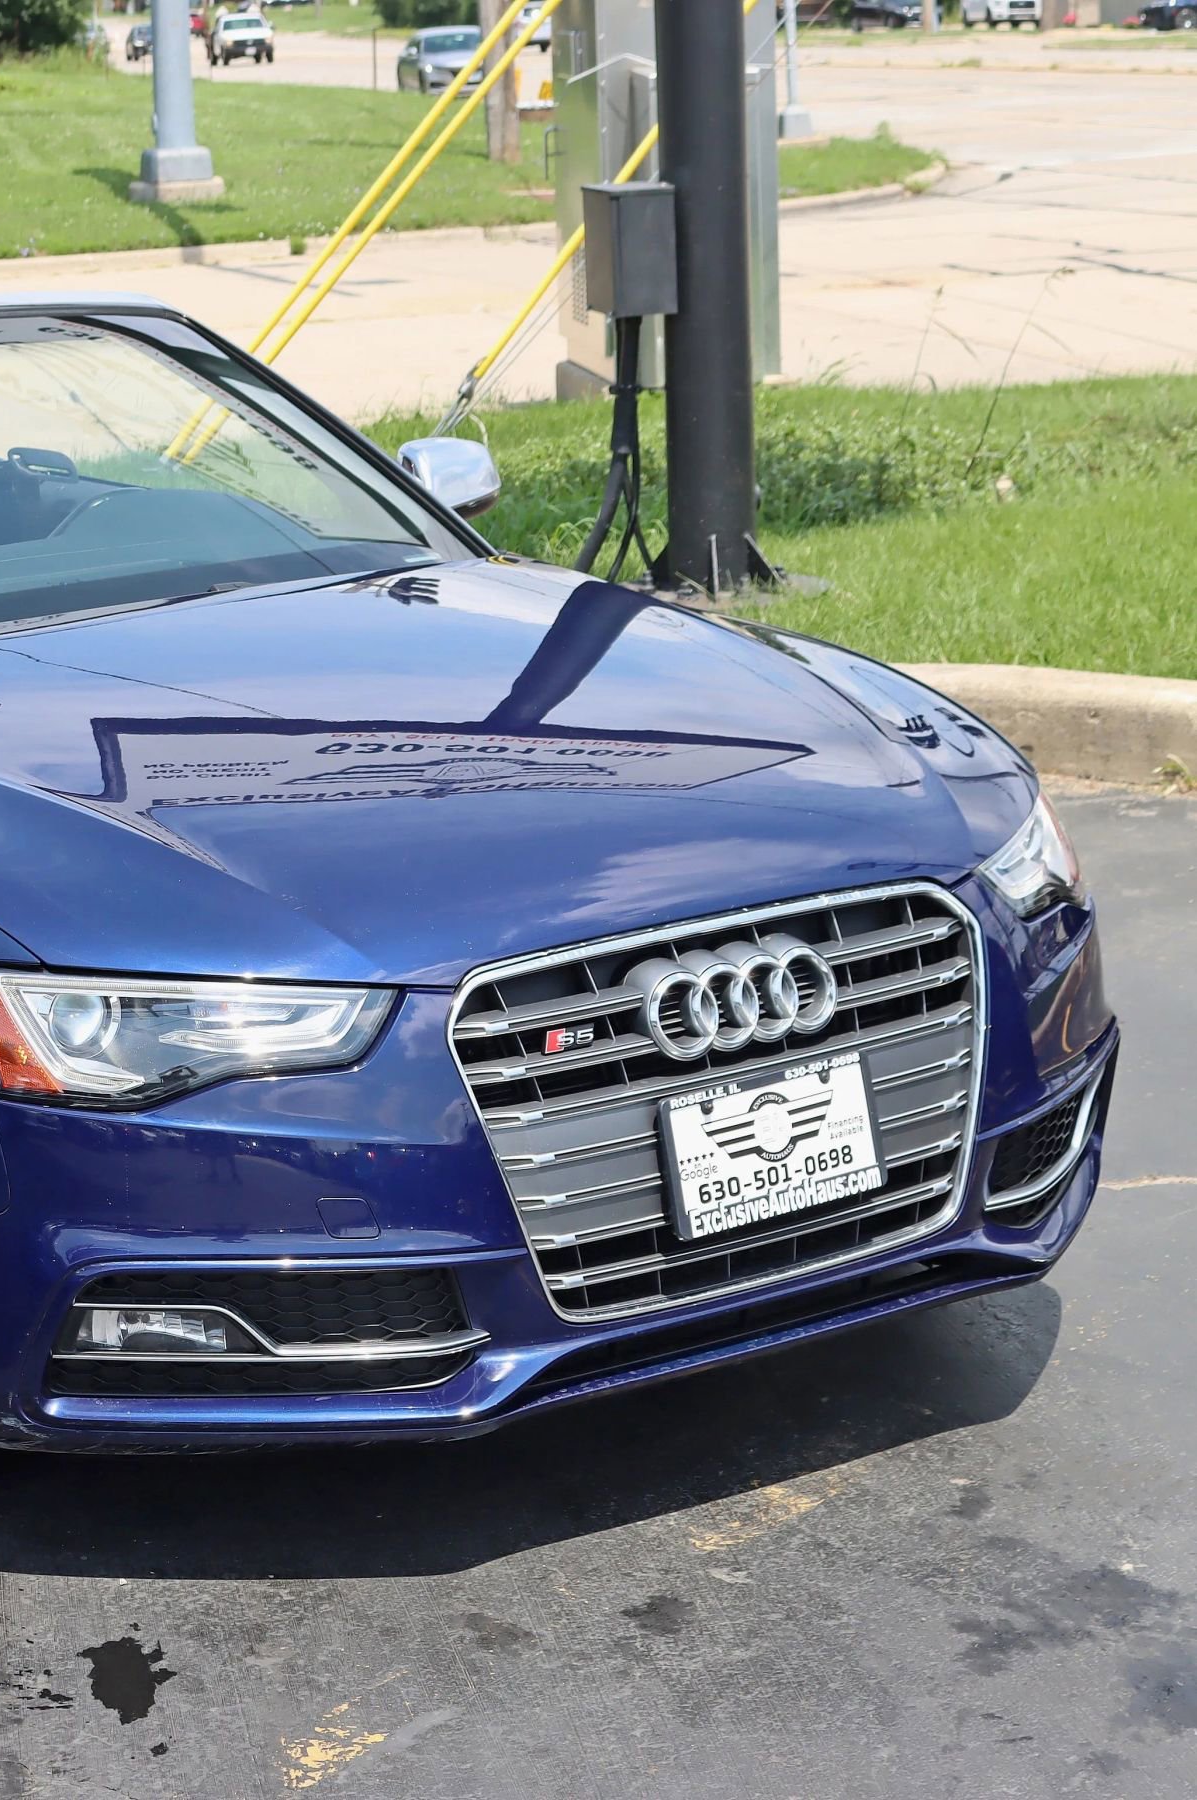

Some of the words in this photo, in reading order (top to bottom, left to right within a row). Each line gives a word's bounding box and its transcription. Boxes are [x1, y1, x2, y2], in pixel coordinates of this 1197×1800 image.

[555, 1028, 594, 1049] S5
[784, 1052, 861, 1080] 630-501-0698
[670, 1087, 727, 1110] ROSELLE,
[728, 1083, 741, 1096] IL
[680, 1163, 718, 1182] Google
[698, 1145, 853, 1205] 630-501-0698
[689, 1166, 883, 1238] ExclusiveAutoHaus.com
